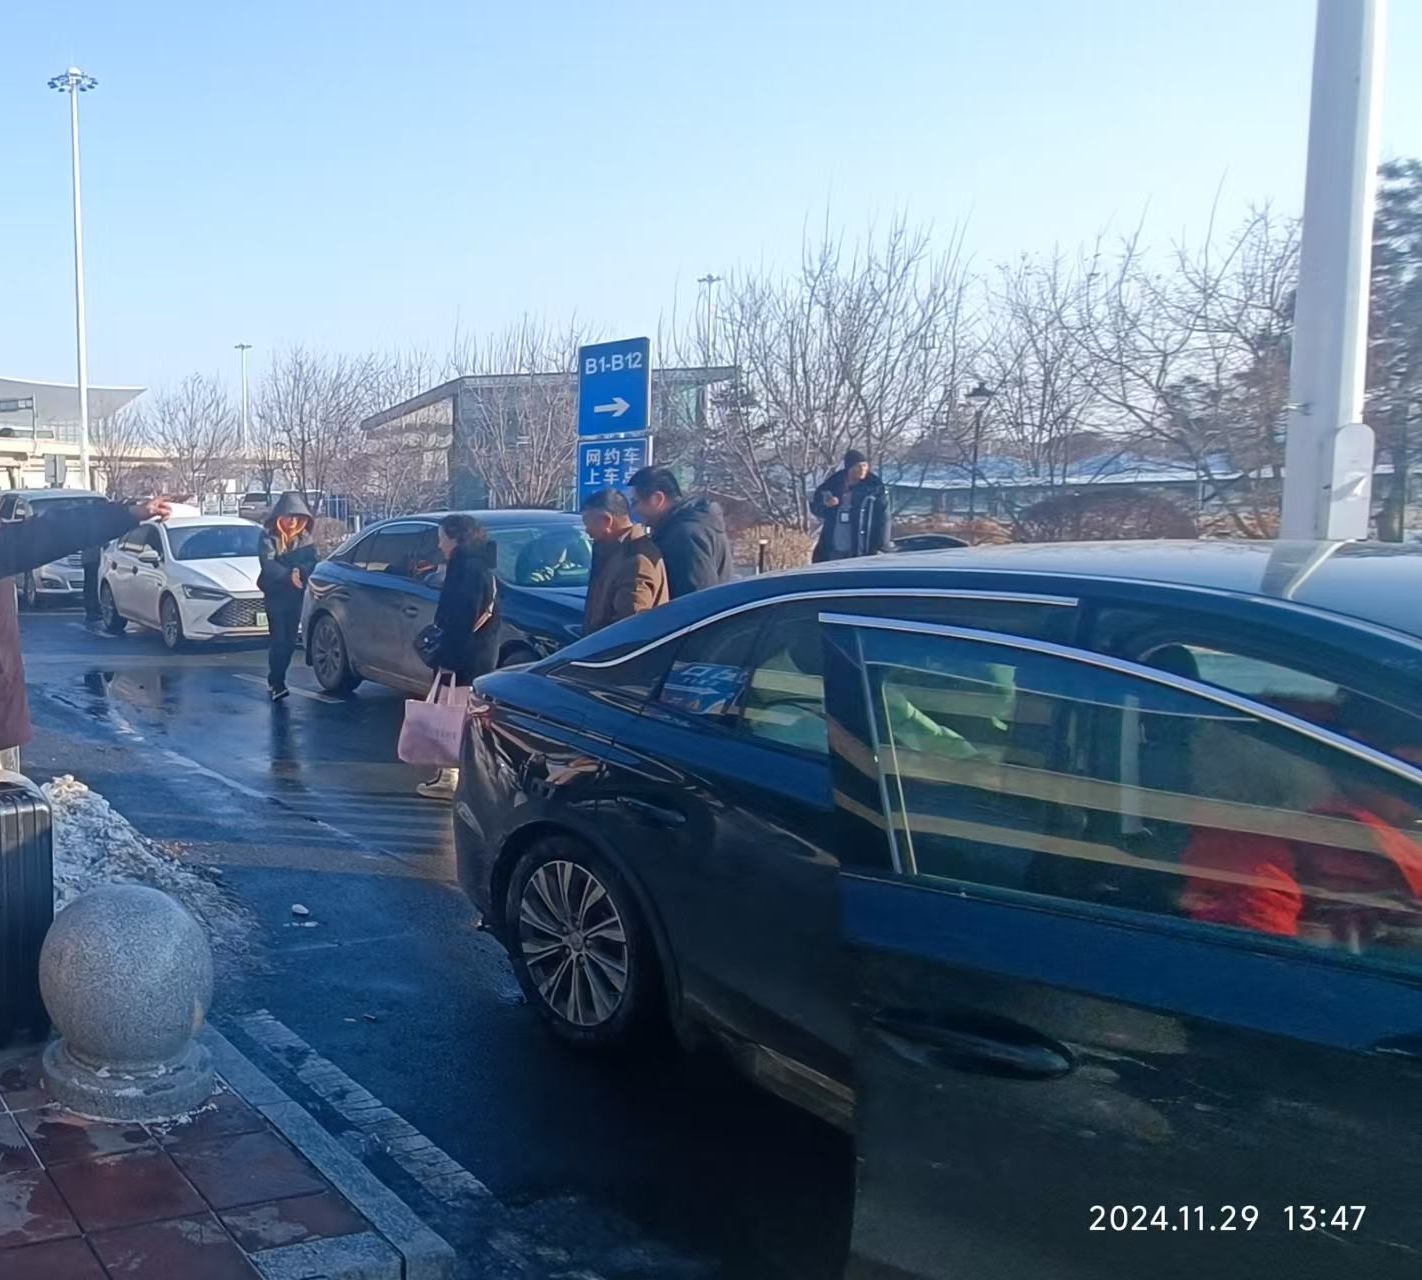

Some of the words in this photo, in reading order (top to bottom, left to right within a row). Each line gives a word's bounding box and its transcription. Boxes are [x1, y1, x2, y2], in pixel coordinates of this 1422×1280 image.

[585, 352, 642, 374] B1-B12
[586, 448, 640, 466] 网约车
